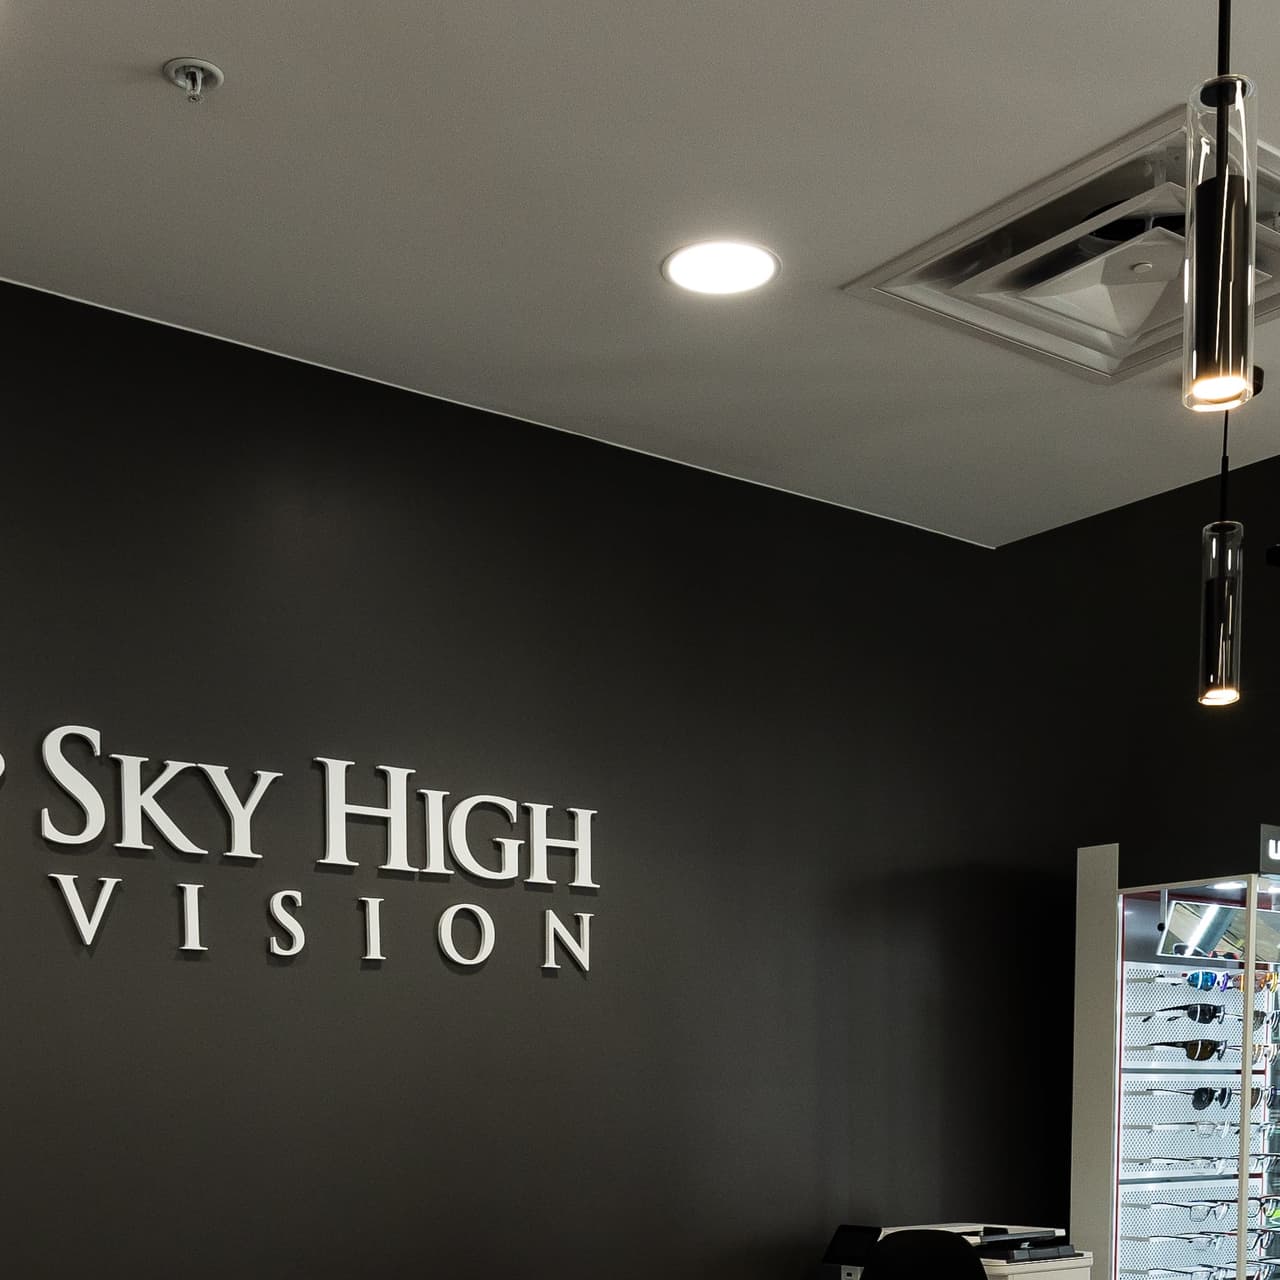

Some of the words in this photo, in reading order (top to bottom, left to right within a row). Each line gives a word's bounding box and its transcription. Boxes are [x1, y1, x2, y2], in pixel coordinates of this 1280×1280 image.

[41, 725, 284, 859] SKY
[313, 756, 601, 889] HIGH
[48, 873, 595, 972] VISION
